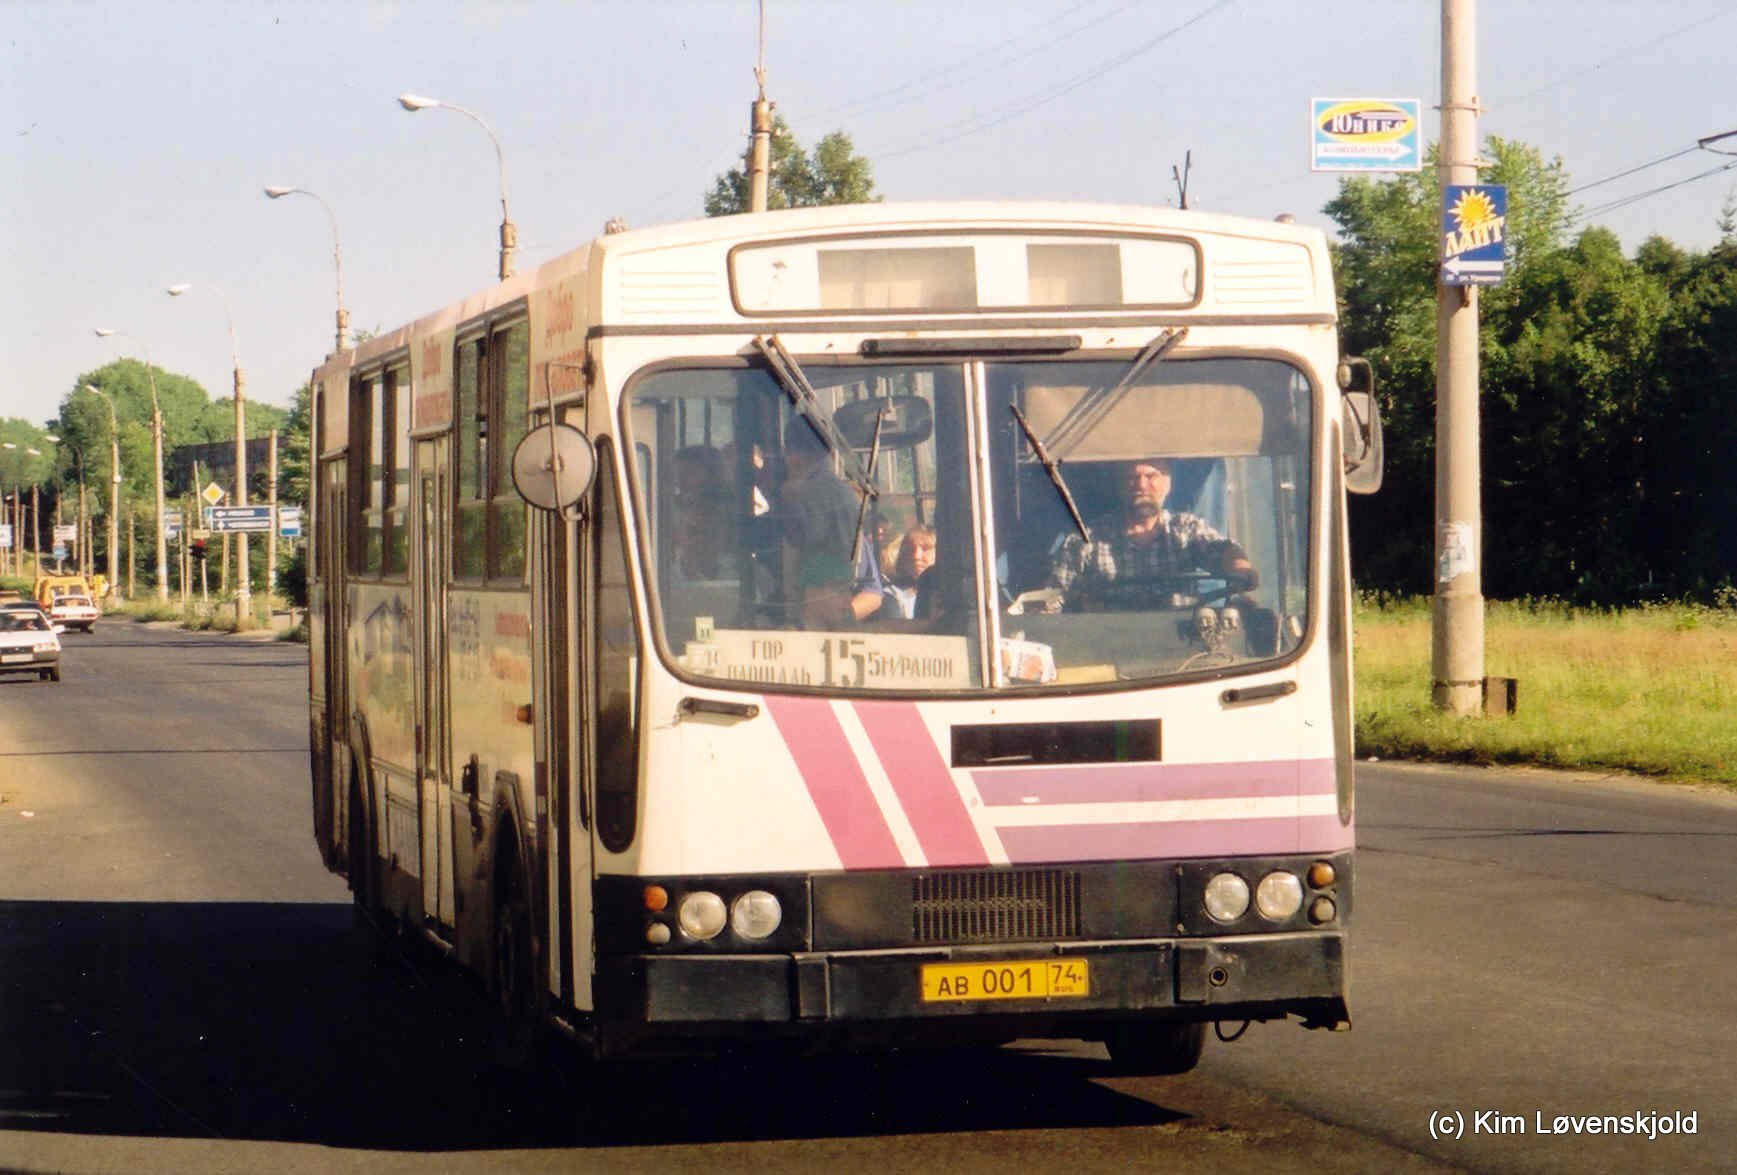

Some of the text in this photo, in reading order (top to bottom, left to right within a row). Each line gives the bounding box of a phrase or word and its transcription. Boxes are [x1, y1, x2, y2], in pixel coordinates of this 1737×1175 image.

[751, 640, 783, 660] ГОР
[820, 639, 865, 686] 15
[937, 964, 1077, 996] АВ 001 74
